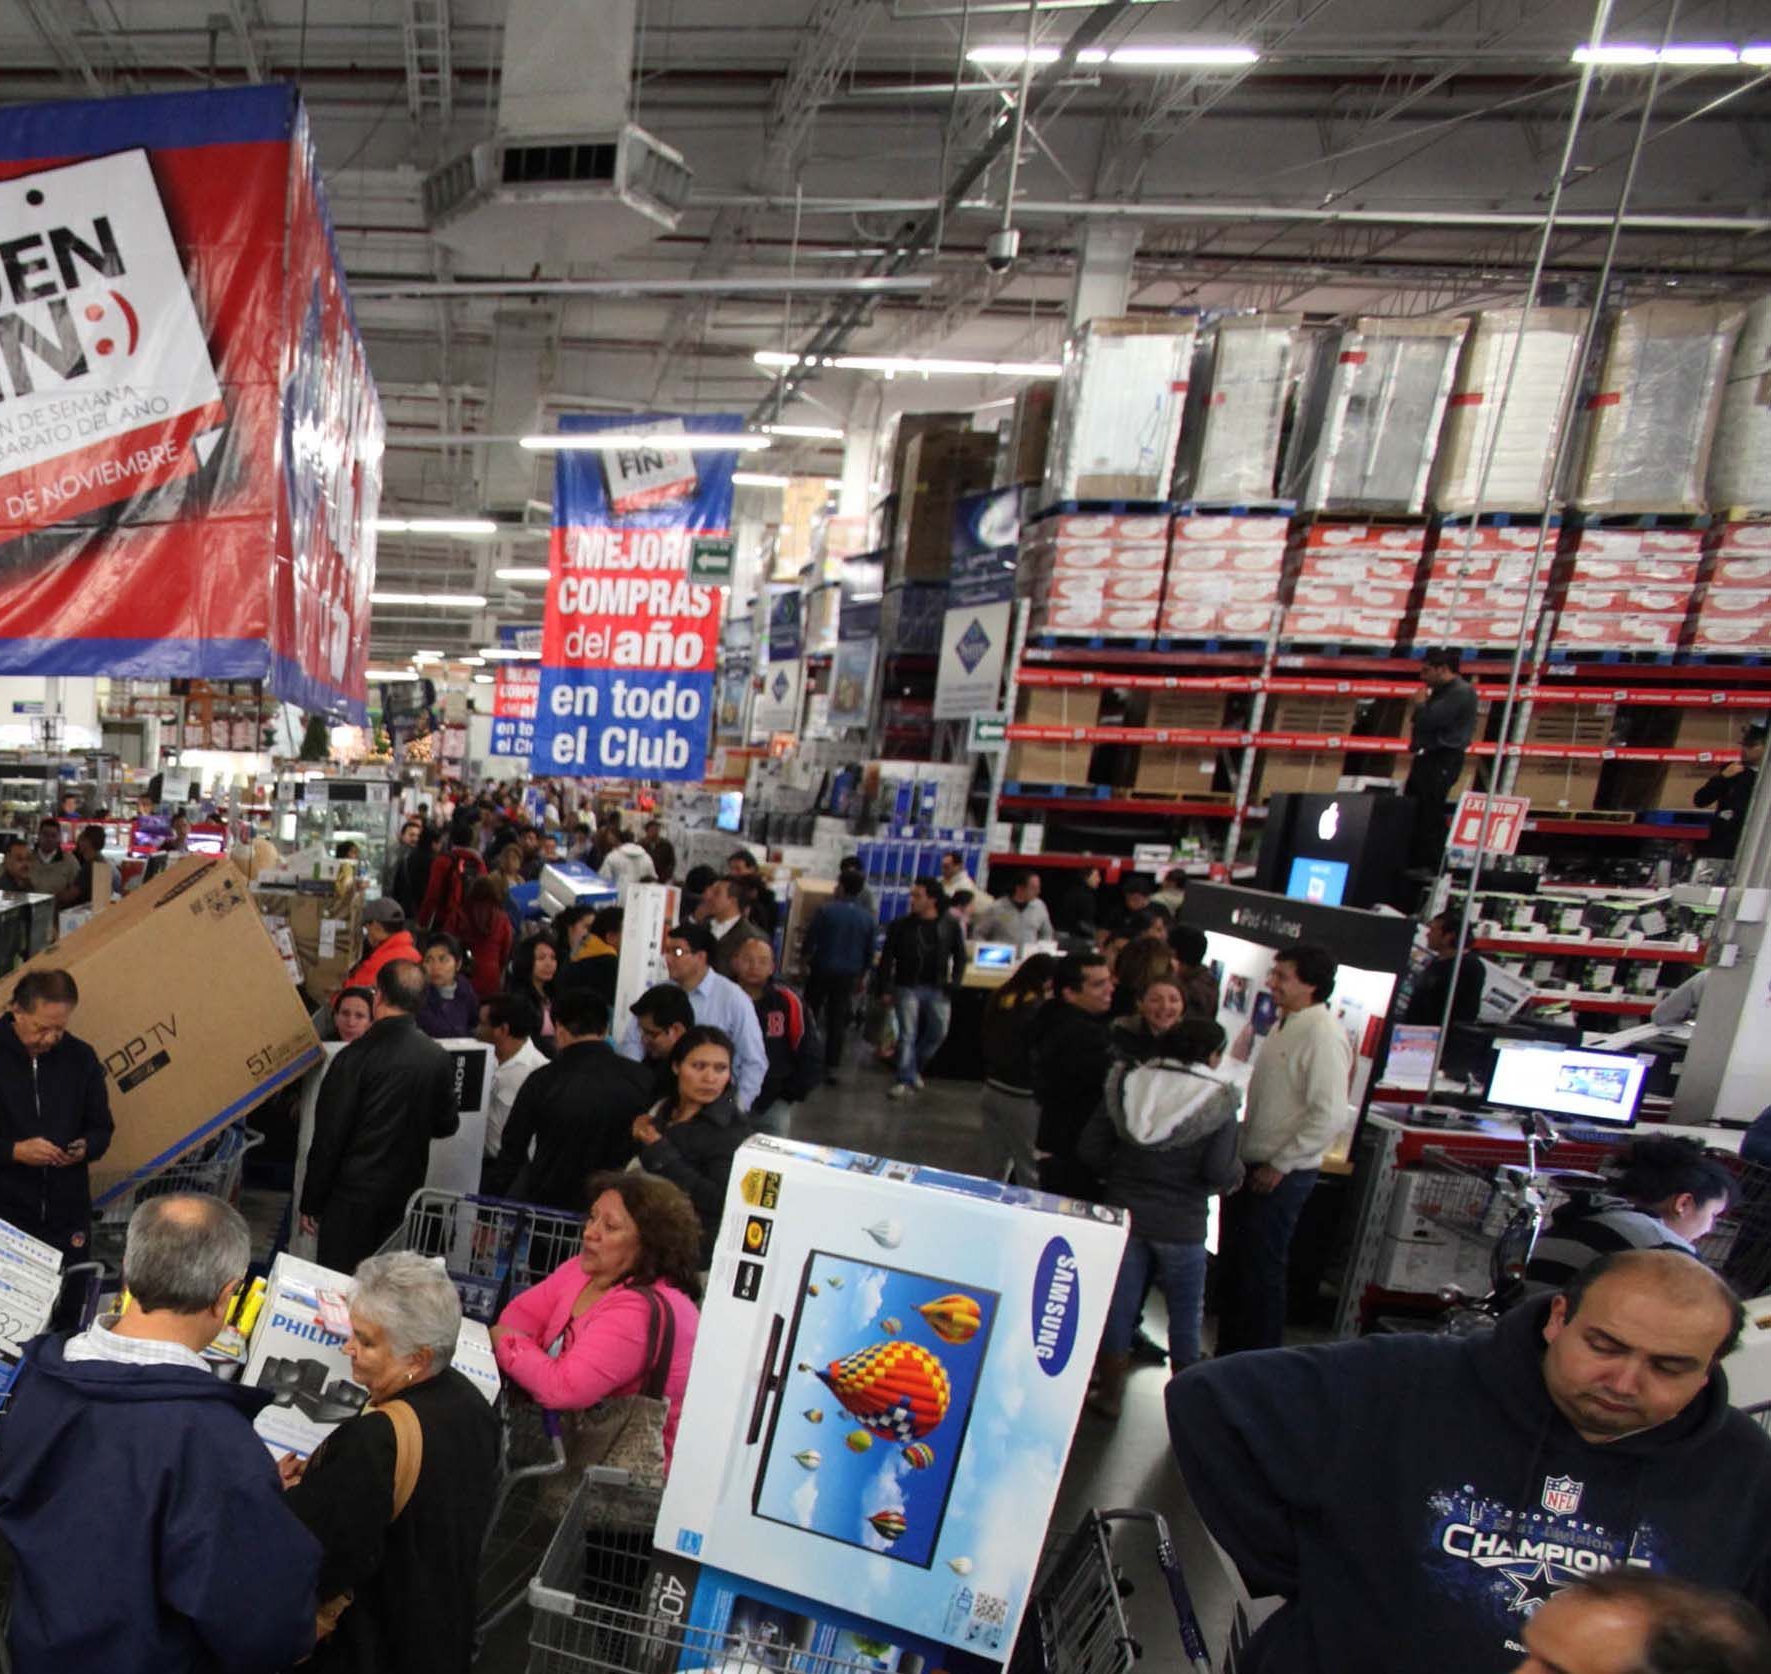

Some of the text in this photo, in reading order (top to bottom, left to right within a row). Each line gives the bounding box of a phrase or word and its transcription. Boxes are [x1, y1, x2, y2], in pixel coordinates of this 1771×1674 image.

[17, 405, 46, 430] DE
[50, 384, 138, 423] SEMANA
[76, 410, 114, 438] DEL
[5, 490, 39, 519] DE
[41, 438, 181, 506] NOVIEMBRE
[578, 532, 692, 572] MEJOR
[557, 576, 713, 618] COMPRAS
[565, 621, 705, 668] del año
[550, 679, 701, 721] en todo
[517, 720, 534, 737] to
[551, 726, 690, 770] el Club
[146, 1012, 178, 1046] TV
[1035, 1253, 1076, 1361] SAMSUNG
[1546, 1491, 1574, 1511] NFL
[1442, 1522, 1652, 1574] CHAMPION
[1543, 1526, 1615, 1552] Division
[1567, 1518, 1606, 1536] NFC
